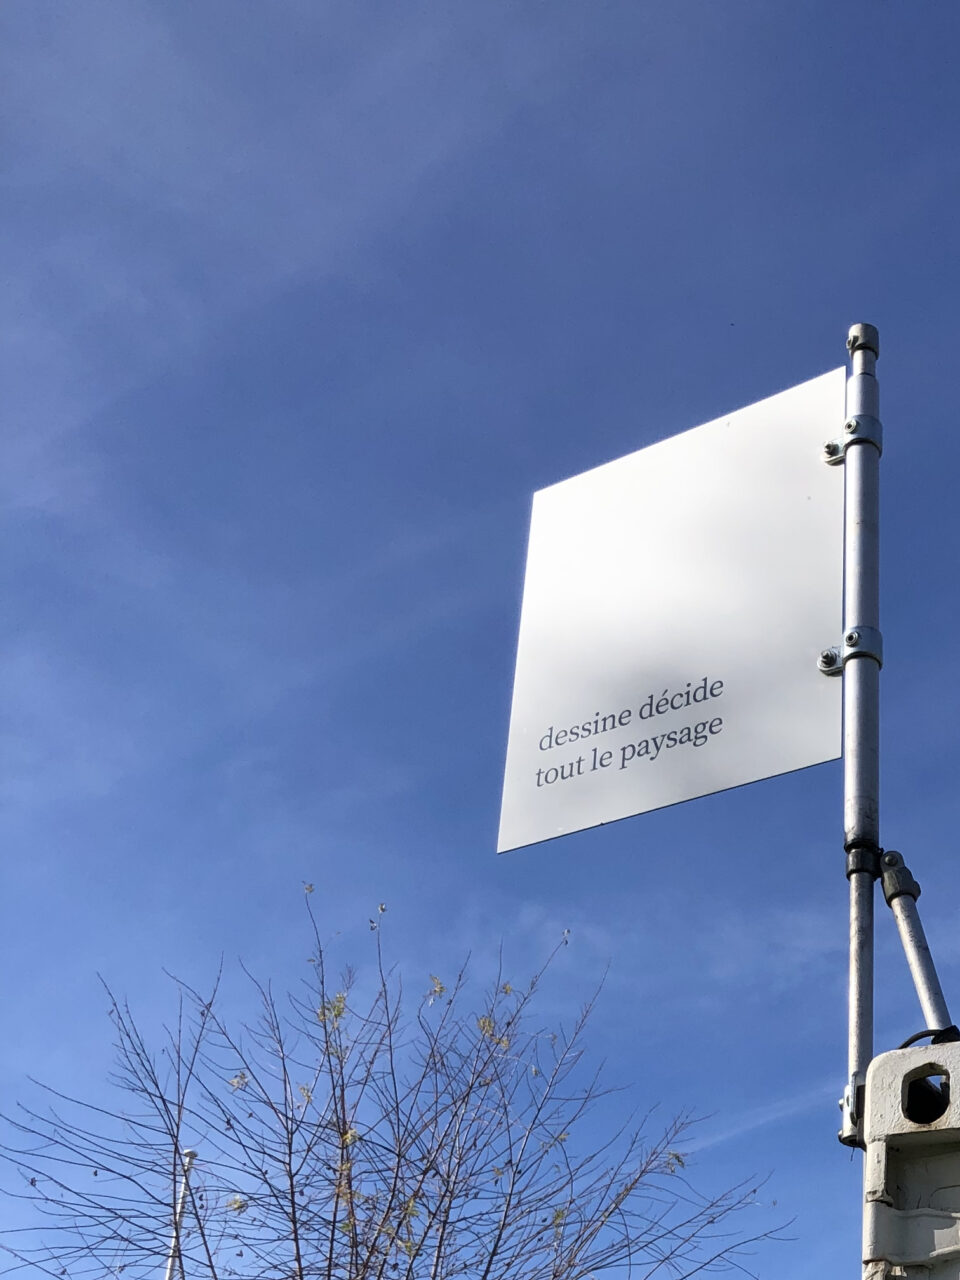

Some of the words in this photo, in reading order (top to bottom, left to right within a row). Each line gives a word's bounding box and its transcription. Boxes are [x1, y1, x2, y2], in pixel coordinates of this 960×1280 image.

[539, 710, 632, 751] dessine
[639, 676, 723, 720] décide
[536, 756, 585, 787] tout
[590, 747, 613, 772] le
[619, 718, 723, 770] paysage
